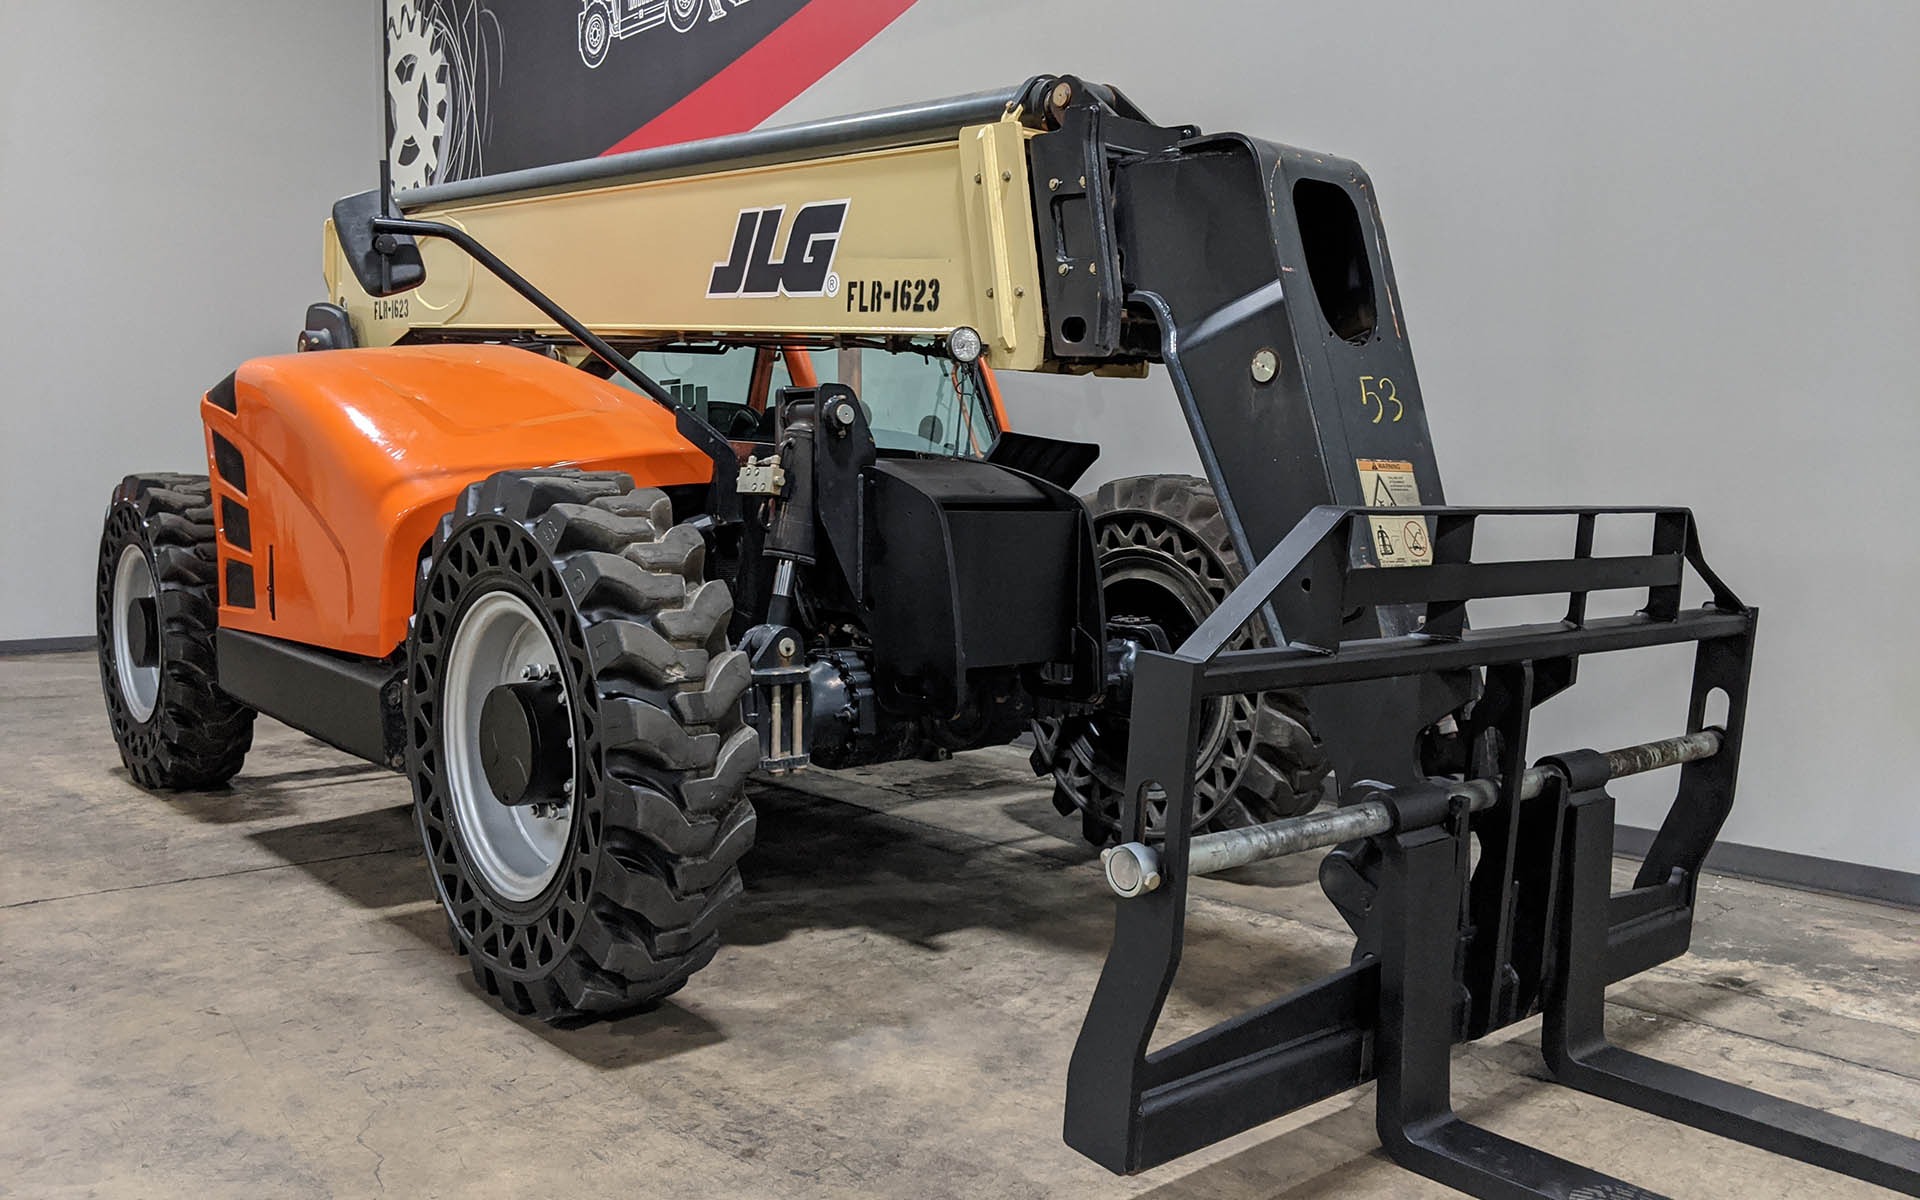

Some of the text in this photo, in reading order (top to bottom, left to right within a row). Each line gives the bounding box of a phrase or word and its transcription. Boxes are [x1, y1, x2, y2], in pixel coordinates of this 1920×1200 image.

[706, 199, 850, 298] JLG
[374, 299, 409, 320] FLR-1623
[847, 279, 940, 312] FLR-1623
[1360, 376, 1403, 424] 53
